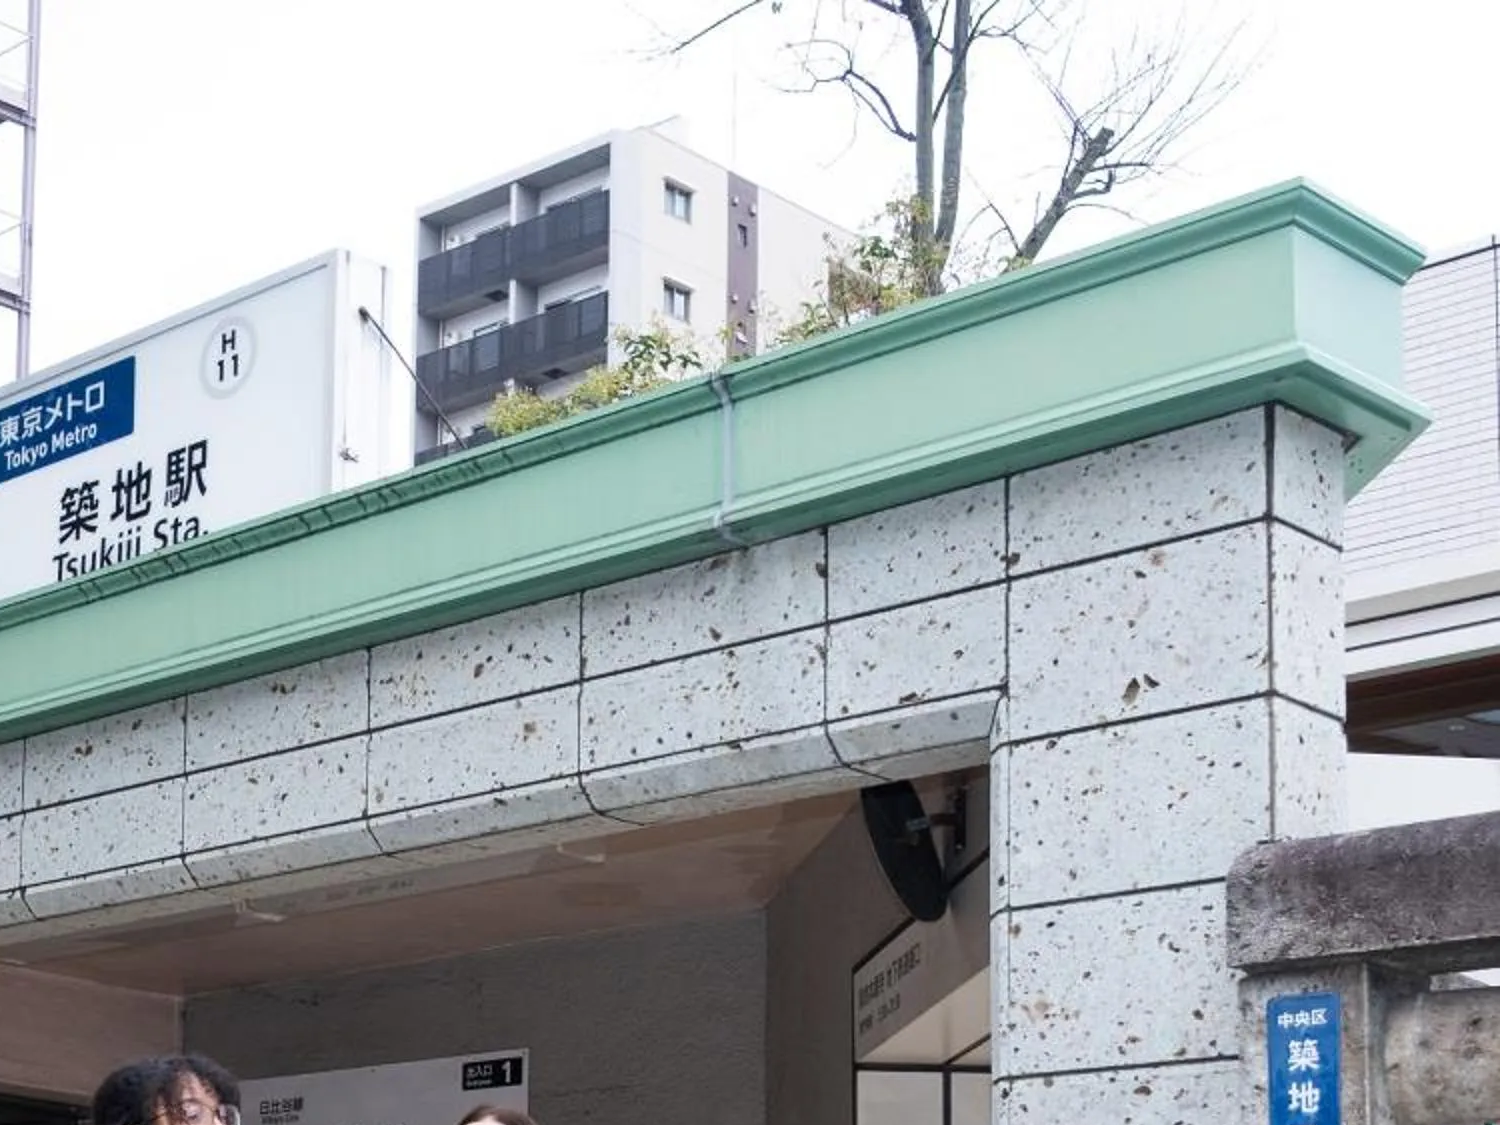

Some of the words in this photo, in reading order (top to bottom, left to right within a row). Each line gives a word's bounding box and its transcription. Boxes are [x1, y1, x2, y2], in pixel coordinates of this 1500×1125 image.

[221, 329, 236, 354] H
[216, 353, 240, 382] 11
[4, 441, 49, 472] Tokyo
[51, 421, 98, 455] Metro
[57, 438, 210, 545] 築地駅
[153, 515, 209, 551] Sta.
[1277, 1007, 1329, 1029] 中央区
[501, 1060, 512, 1084] 1
